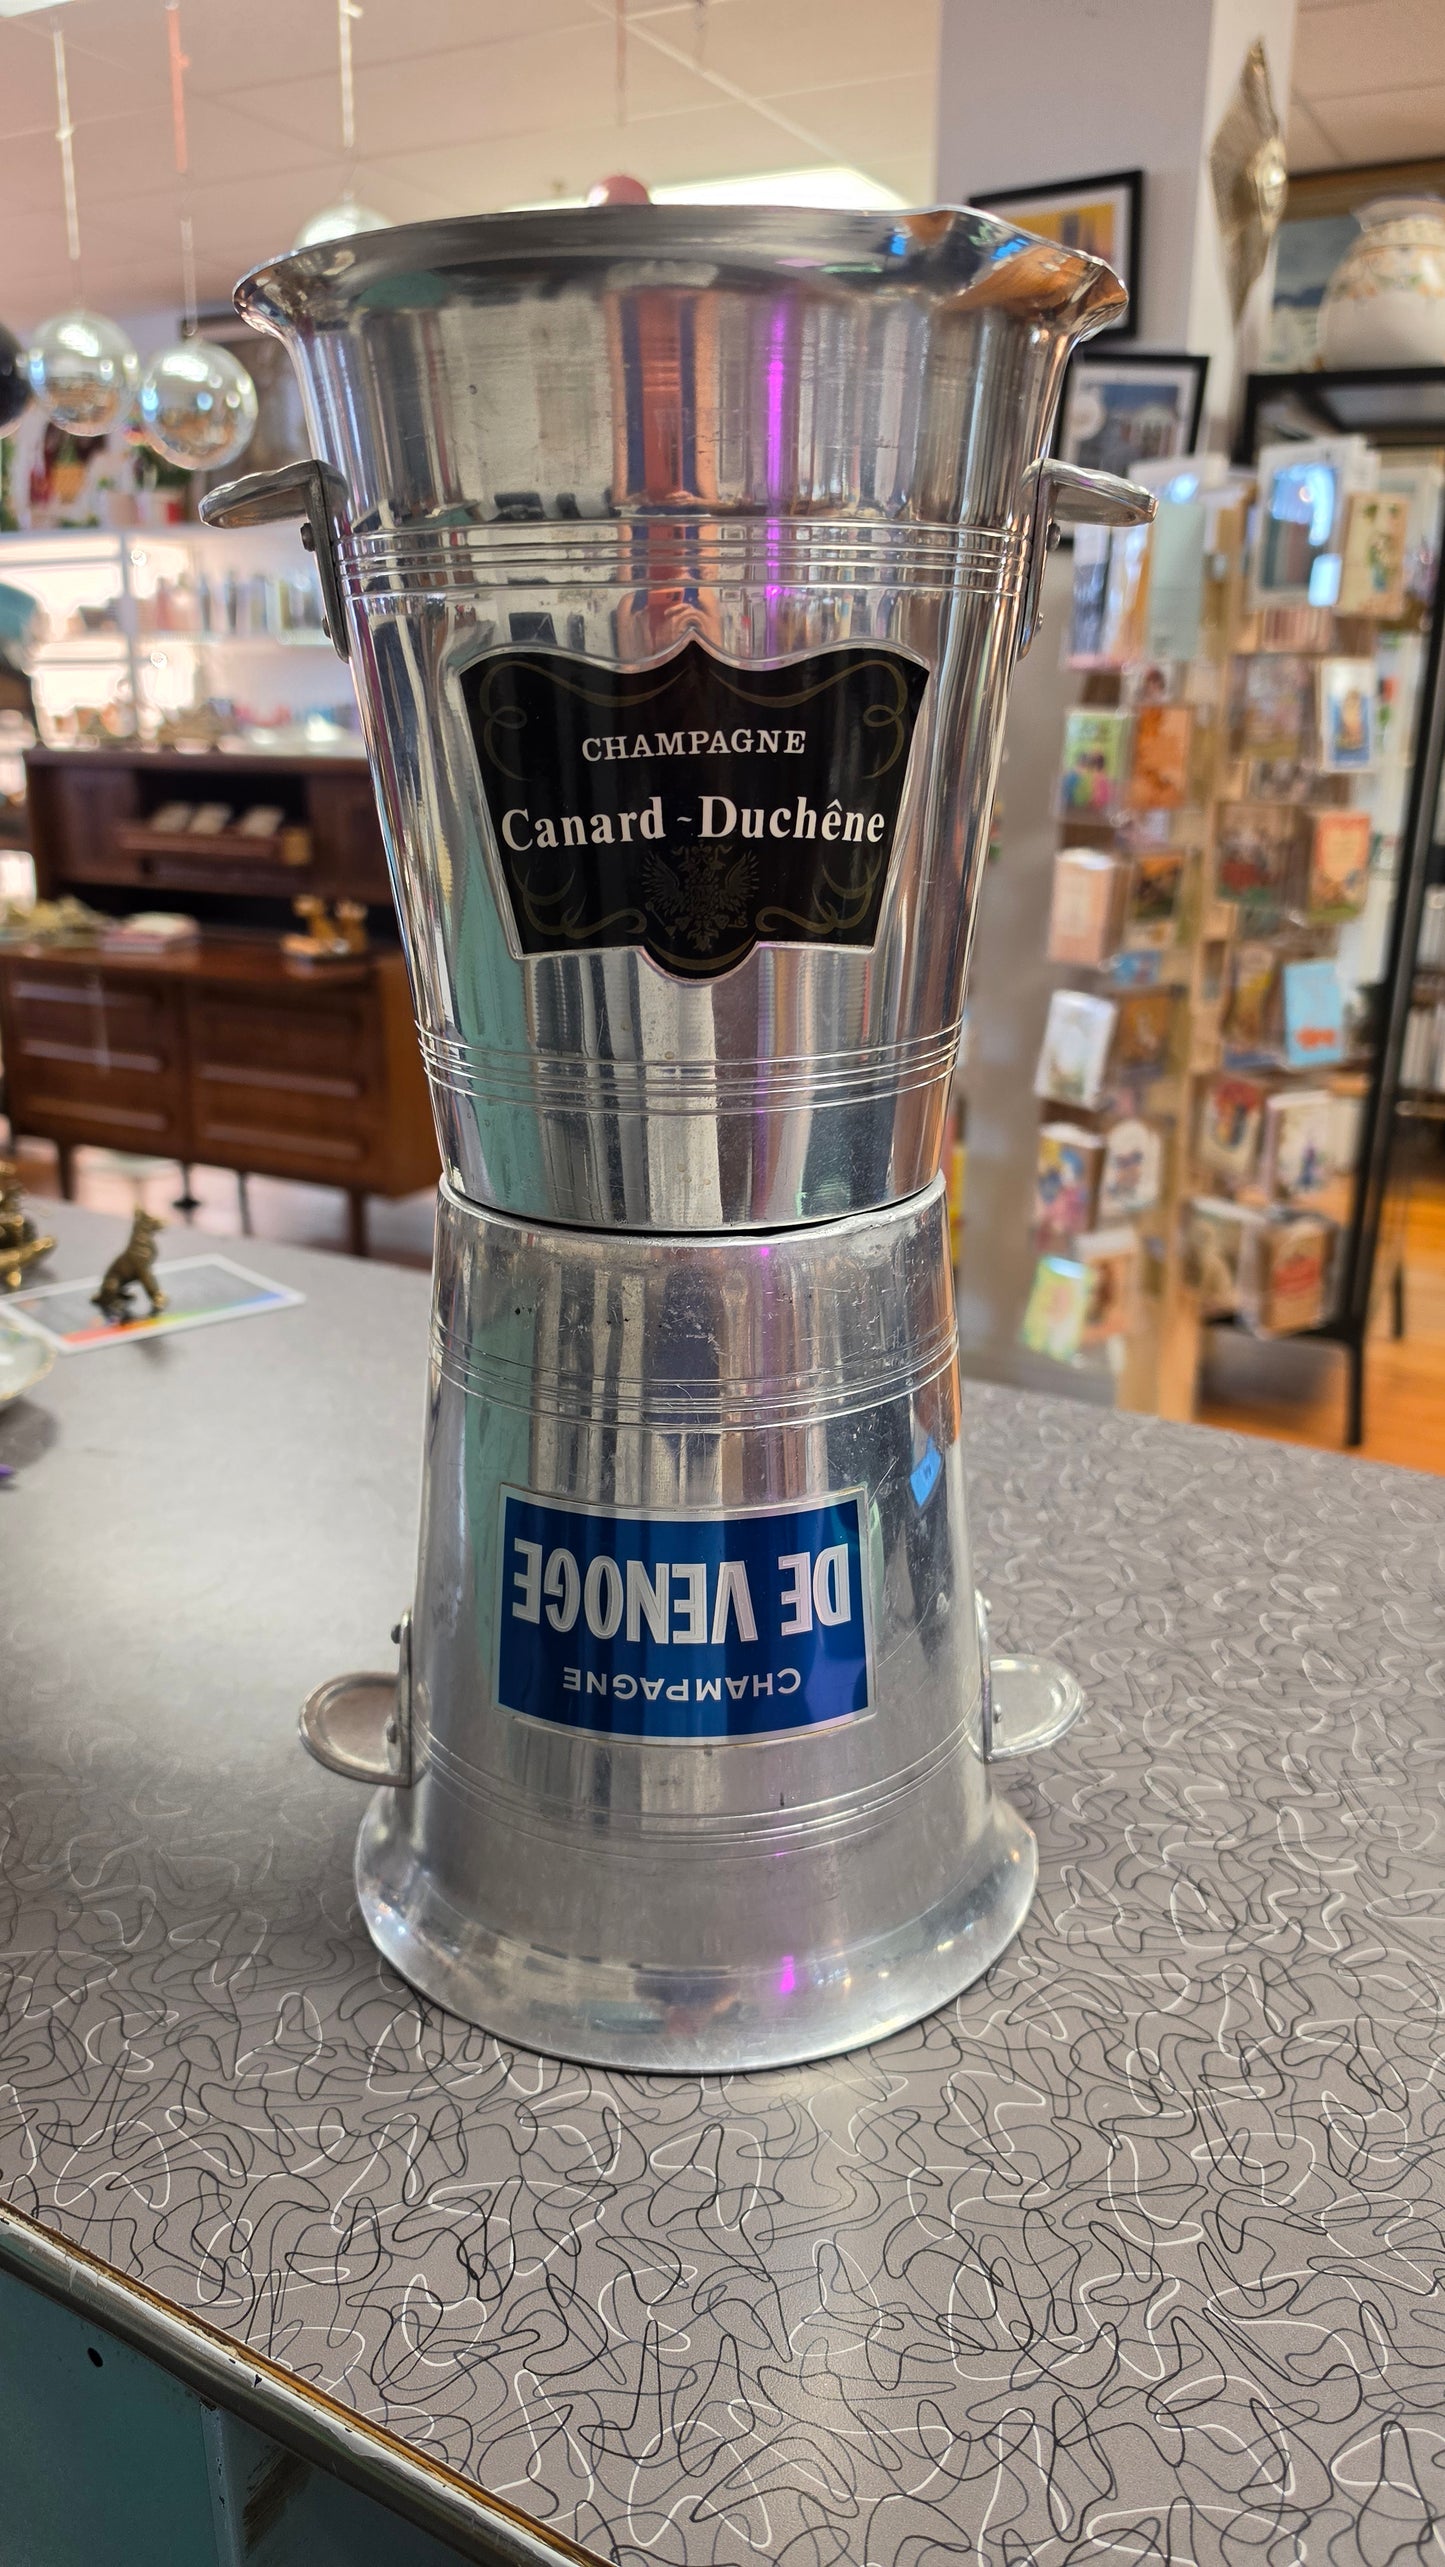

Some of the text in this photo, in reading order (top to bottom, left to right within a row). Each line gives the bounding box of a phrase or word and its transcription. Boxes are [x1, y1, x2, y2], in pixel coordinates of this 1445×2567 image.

[582, 729, 806, 762] CHAMPAGNE
[511, 1537, 852, 1645] DE VENOGE
[562, 1666, 801, 1702] CHAMPAGNE
